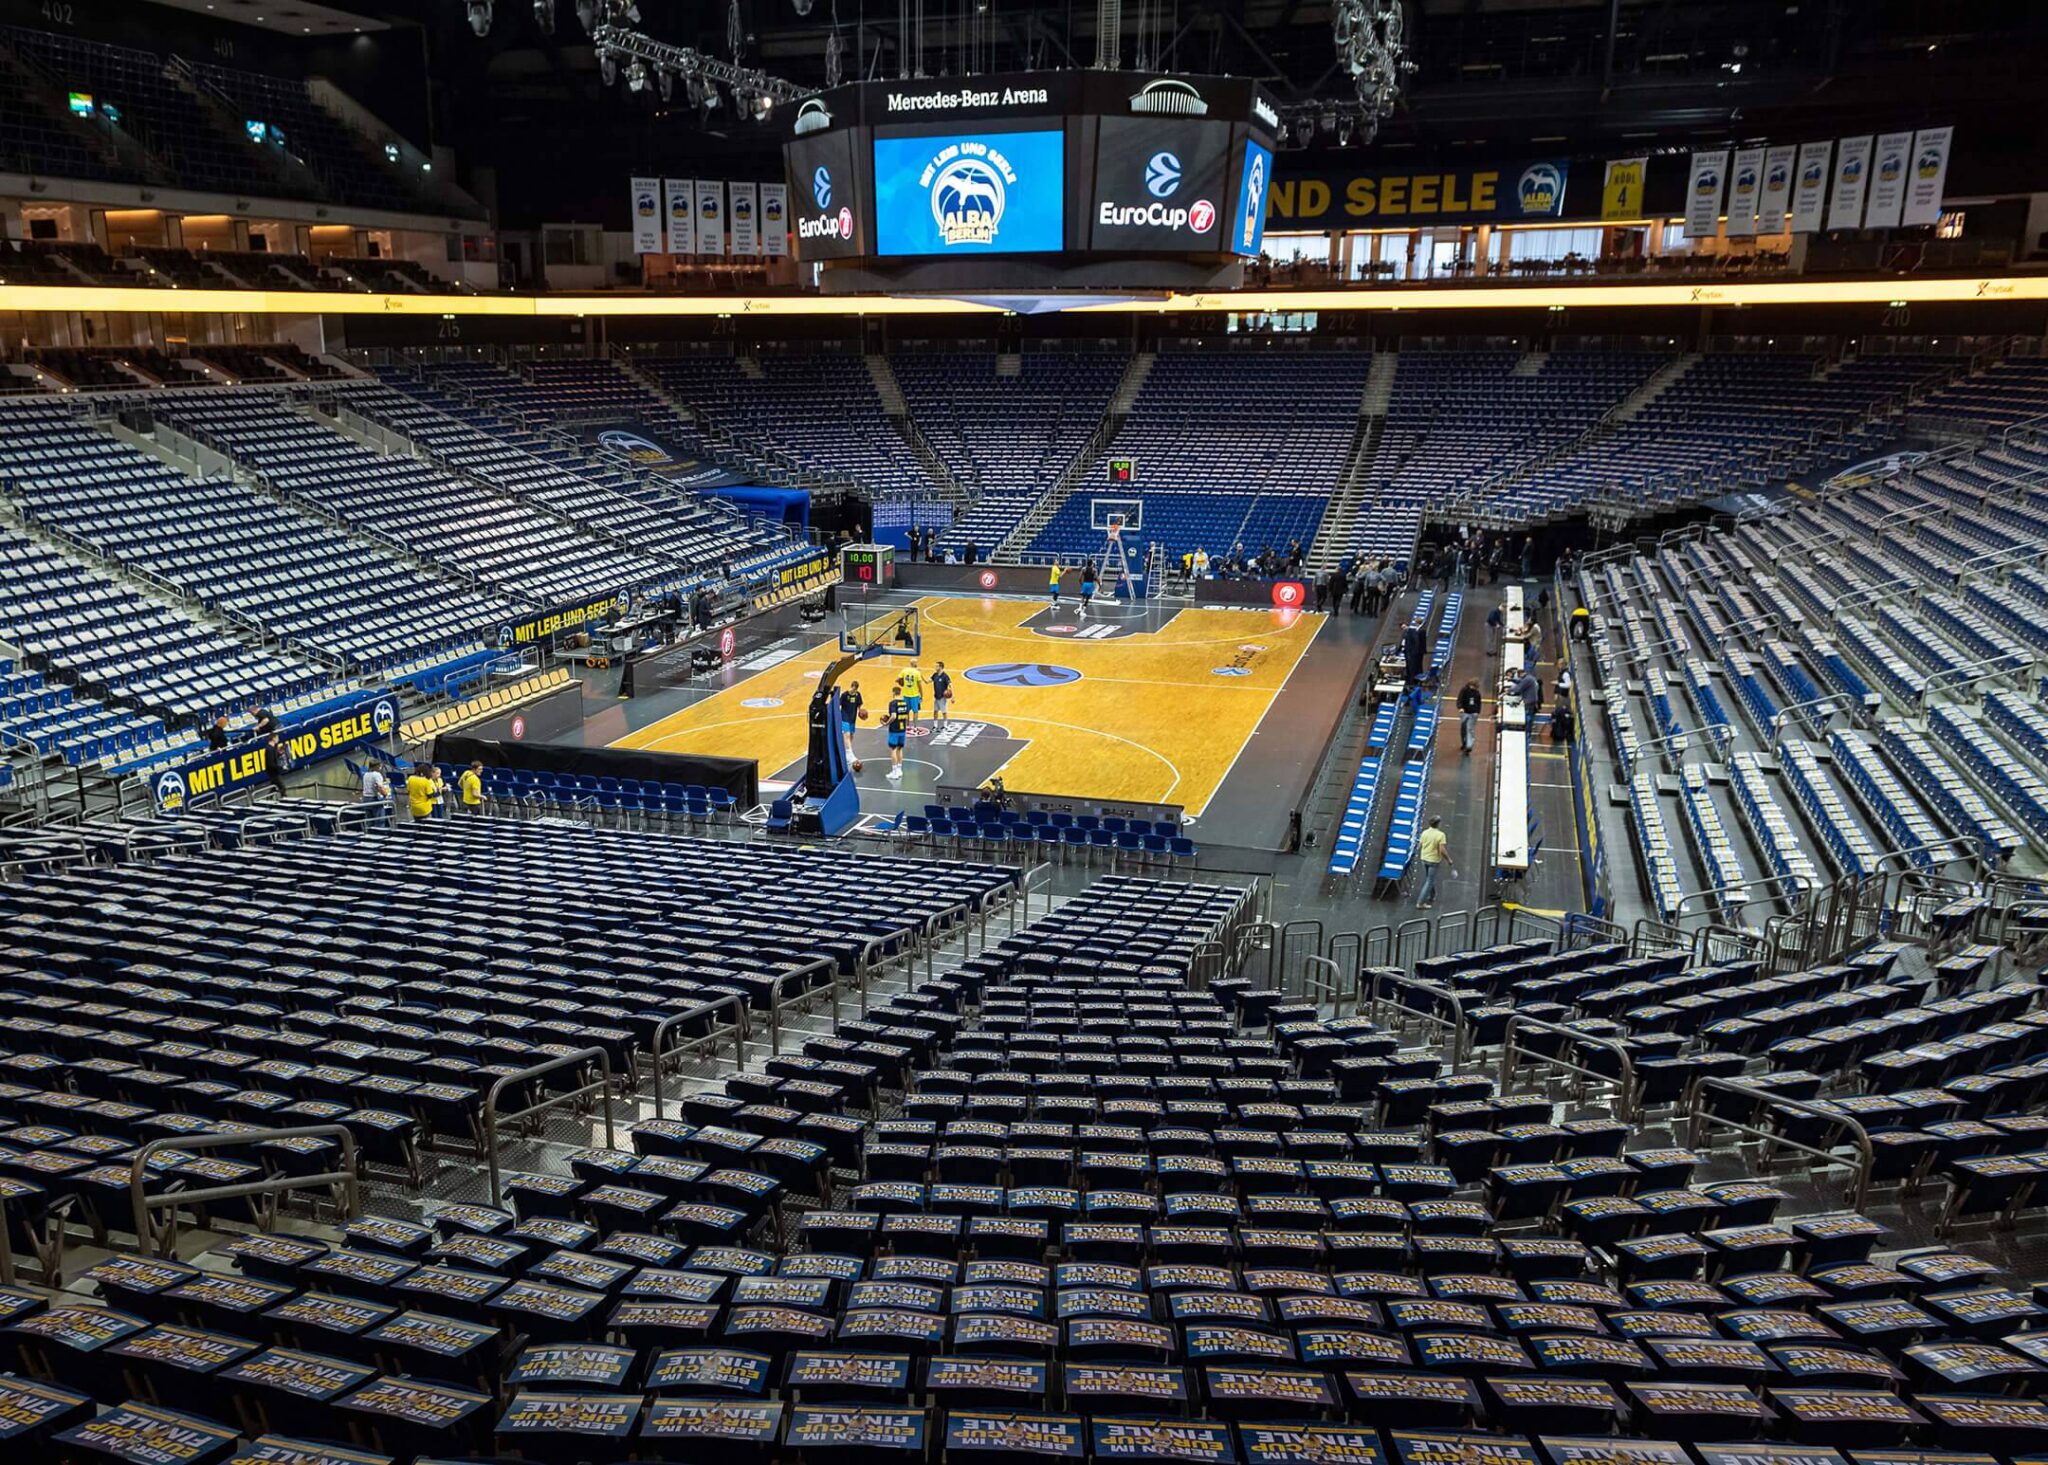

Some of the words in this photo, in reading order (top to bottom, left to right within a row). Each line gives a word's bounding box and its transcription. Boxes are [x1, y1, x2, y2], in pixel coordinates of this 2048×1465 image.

[41, 1, 75, 25] 402
[887, 89, 999, 111] Mercedes-Benz
[1001, 87, 1048, 105] Arena
[919, 162, 937, 188] MIT
[933, 144, 960, 168] LEIB
[961, 142, 988, 157] UND
[987, 149, 1018, 186] SEELE
[1343, 171, 1500, 215] SEELE
[1524, 192, 1553, 203] ALBA
[1617, 186, 1628, 208] 4
[944, 209, 993, 230] ALBA
[1099, 202, 1187, 230] EuroCup
[798, 214, 839, 239] EuroCup
[1881, 309, 1911, 326] 210
[439, 321, 460, 338] 215
[781, 569, 793, 583] MIT
[793, 563, 809, 579] LEIB
[809, 560, 822, 575] UND
[859, 565, 872, 580] 10
[515, 623, 536, 644] MIT
[538, 614, 562, 637] LEIB
[563, 607, 586, 628] UND
[188, 764, 225, 796] MIT
[320, 713, 373, 749] SEELE
[520, 1301, 573, 1316] BERN
[547, 1369, 612, 1378] BERN
[687, 1374, 751, 1385] BERN
[828, 1374, 893, 1383] BERN
[263, 1374, 331, 1394] BERN
[967, 1378, 1031, 1388] BERN
[1106, 1385, 1173, 1394] BERN
[1250, 1389, 1317, 1399] BERN
[378, 1403, 447, 1422] BERN
[523, 1402, 626, 1414] FINALE
[665, 1407, 766, 1419] FINALE
[541, 1420, 616, 1431] BERN
[807, 1413, 909, 1426] FINALE
[964, 1419, 1067, 1433] FINALE
[658, 1425, 683, 1433] IM
[688, 1425, 761, 1435] BERN
[1108, 1425, 1215, 1440] FINALE
[803, 1433, 827, 1441] IM
[834, 1432, 906, 1443] BERN
[961, 1437, 986, 1446] IM
[1256, 1431, 1368, 1446] FINALE
[103, 1436, 180, 1463] BERN
[992, 1438, 1066, 1450] BERN
[1109, 1445, 1134, 1453] IM
[1139, 1445, 1218, 1458] BERN
[1260, 1452, 1287, 1460] IM
[1292, 1452, 1372, 1464] BERN
